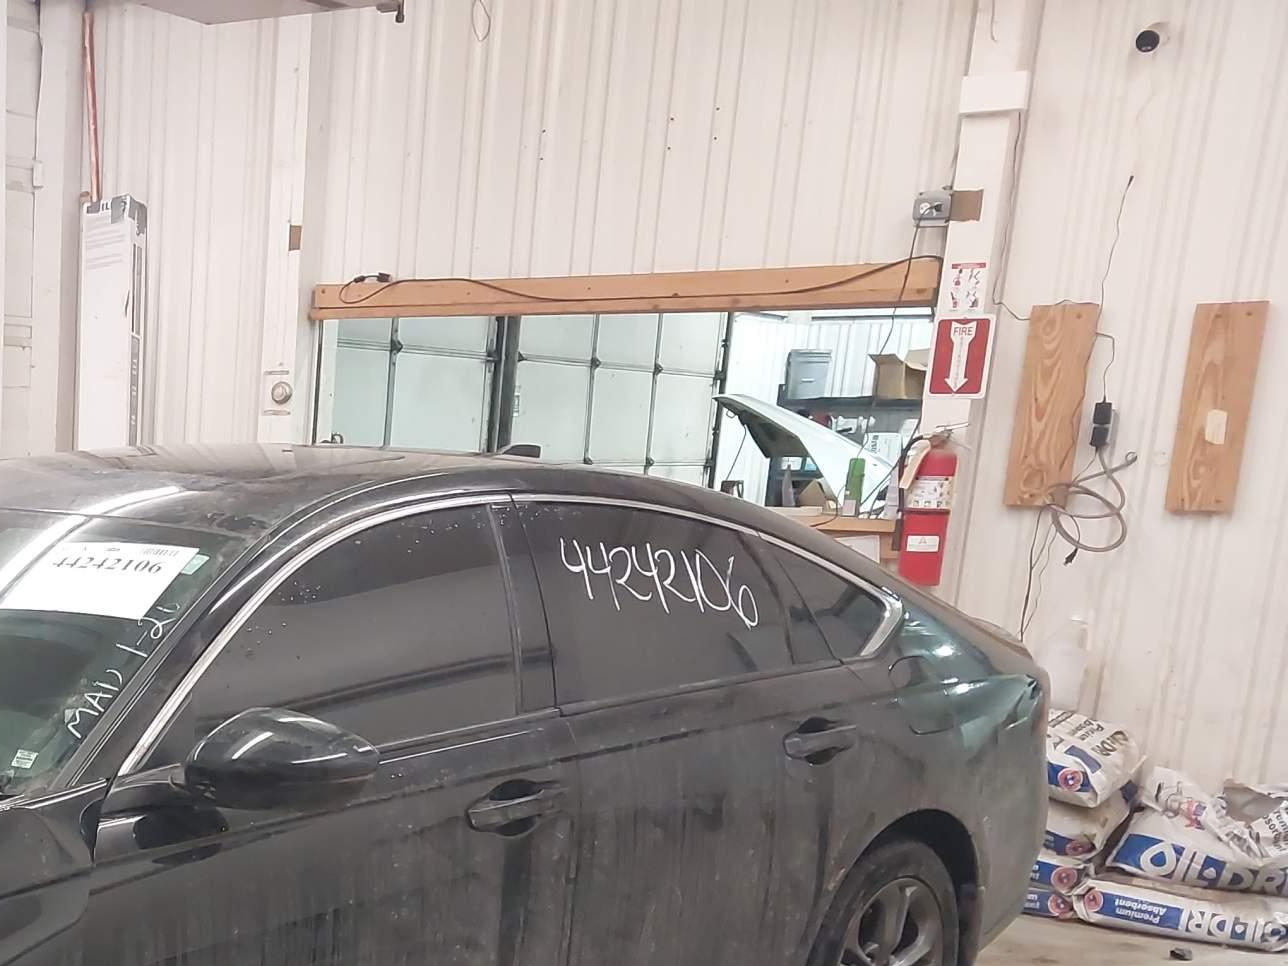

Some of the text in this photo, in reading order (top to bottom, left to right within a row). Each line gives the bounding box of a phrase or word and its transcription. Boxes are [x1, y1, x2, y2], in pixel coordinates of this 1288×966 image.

[953, 327, 974, 337] FIRE
[53, 556, 165, 574] 44242106
[560, 537, 759, 630] 44242106
[1114, 898, 1168, 916] Absorbent
[1115, 907, 1161, 924] Premium
